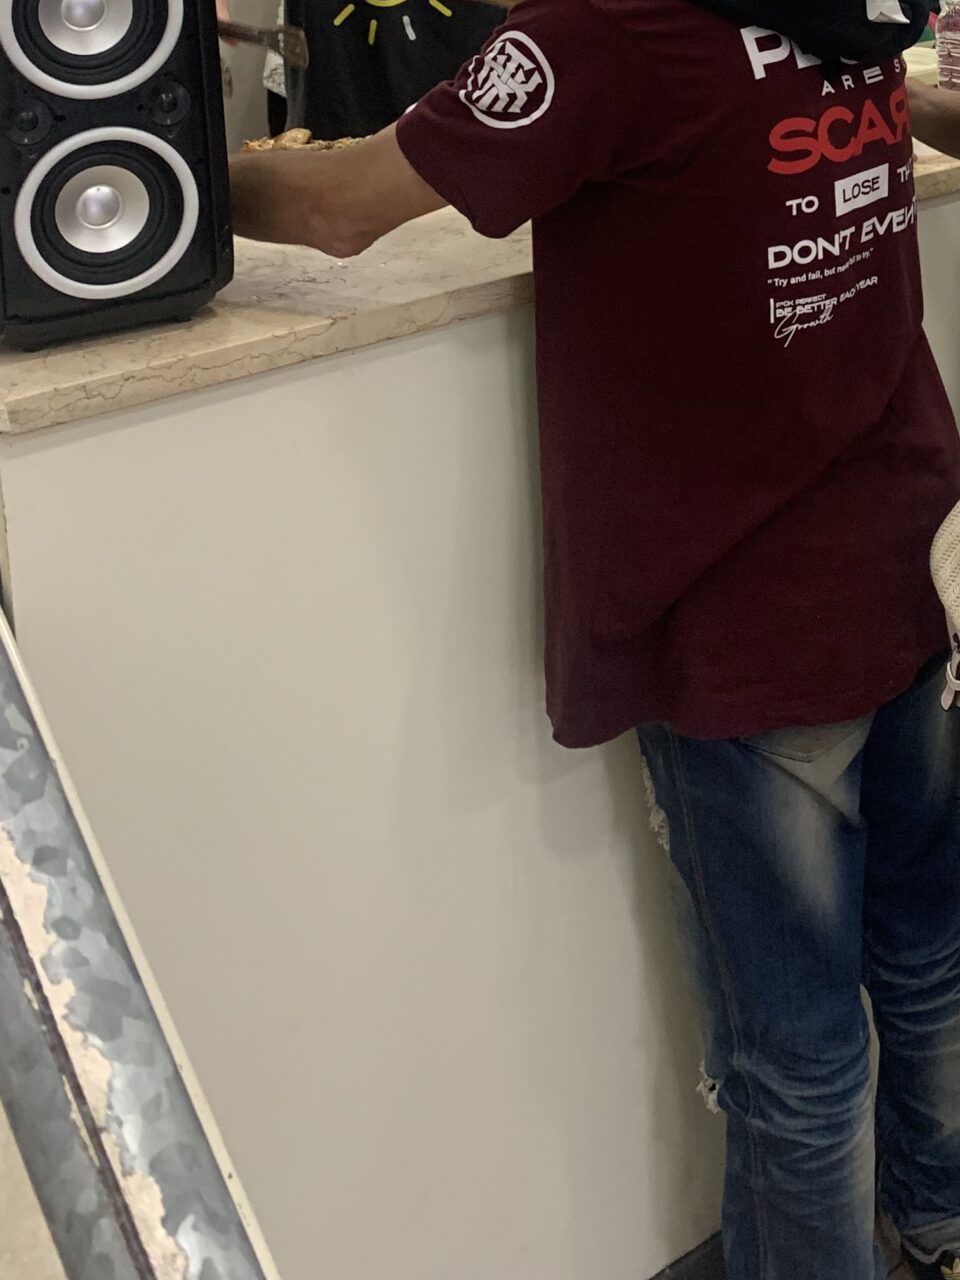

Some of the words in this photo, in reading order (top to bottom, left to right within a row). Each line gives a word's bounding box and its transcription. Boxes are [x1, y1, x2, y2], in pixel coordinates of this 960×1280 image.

[821, 65, 884, 97] ARE
[785, 195, 819, 216] TO
[842, 175, 881, 204] LOSE
[767, 226, 856, 271] DON'T
[775, 306, 793, 318] BE
[795, 296, 838, 315] BETTER
[855, 276, 879, 291] YEAR
[789, 273, 807, 285] and
[795, 293, 827, 306] PERFECT
